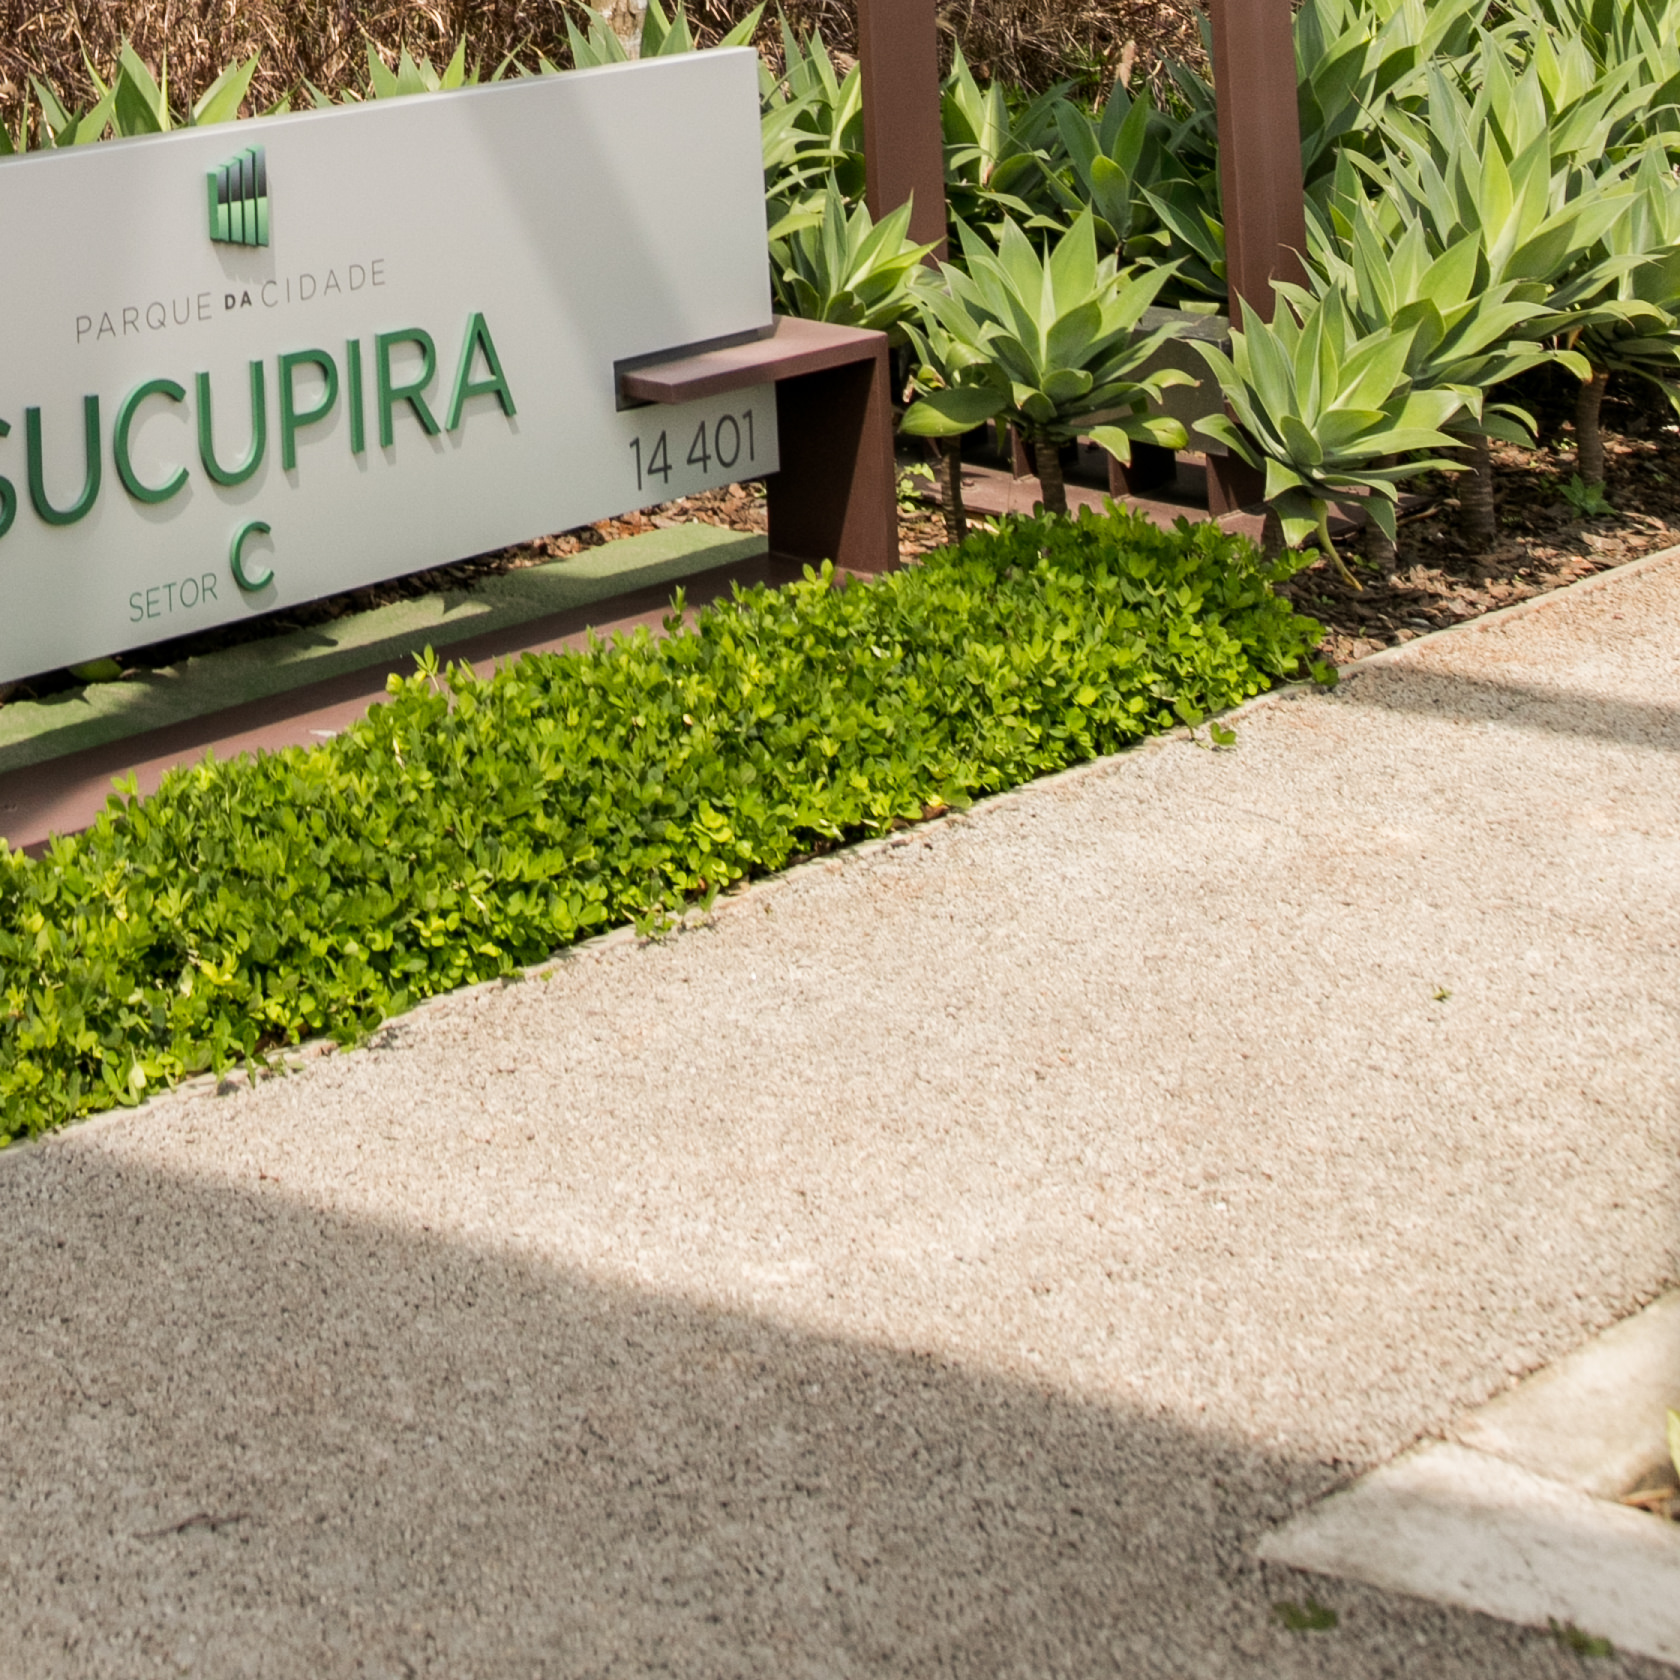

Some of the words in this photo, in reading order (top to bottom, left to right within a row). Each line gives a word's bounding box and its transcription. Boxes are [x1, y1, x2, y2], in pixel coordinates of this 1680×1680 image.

[75, 292, 213, 344] PARQUE
[224, 290, 253, 311] DA
[261, 258, 386, 308] CIDADE
[128, 573, 218, 623] SETOR
[229, 520, 274, 592] C
